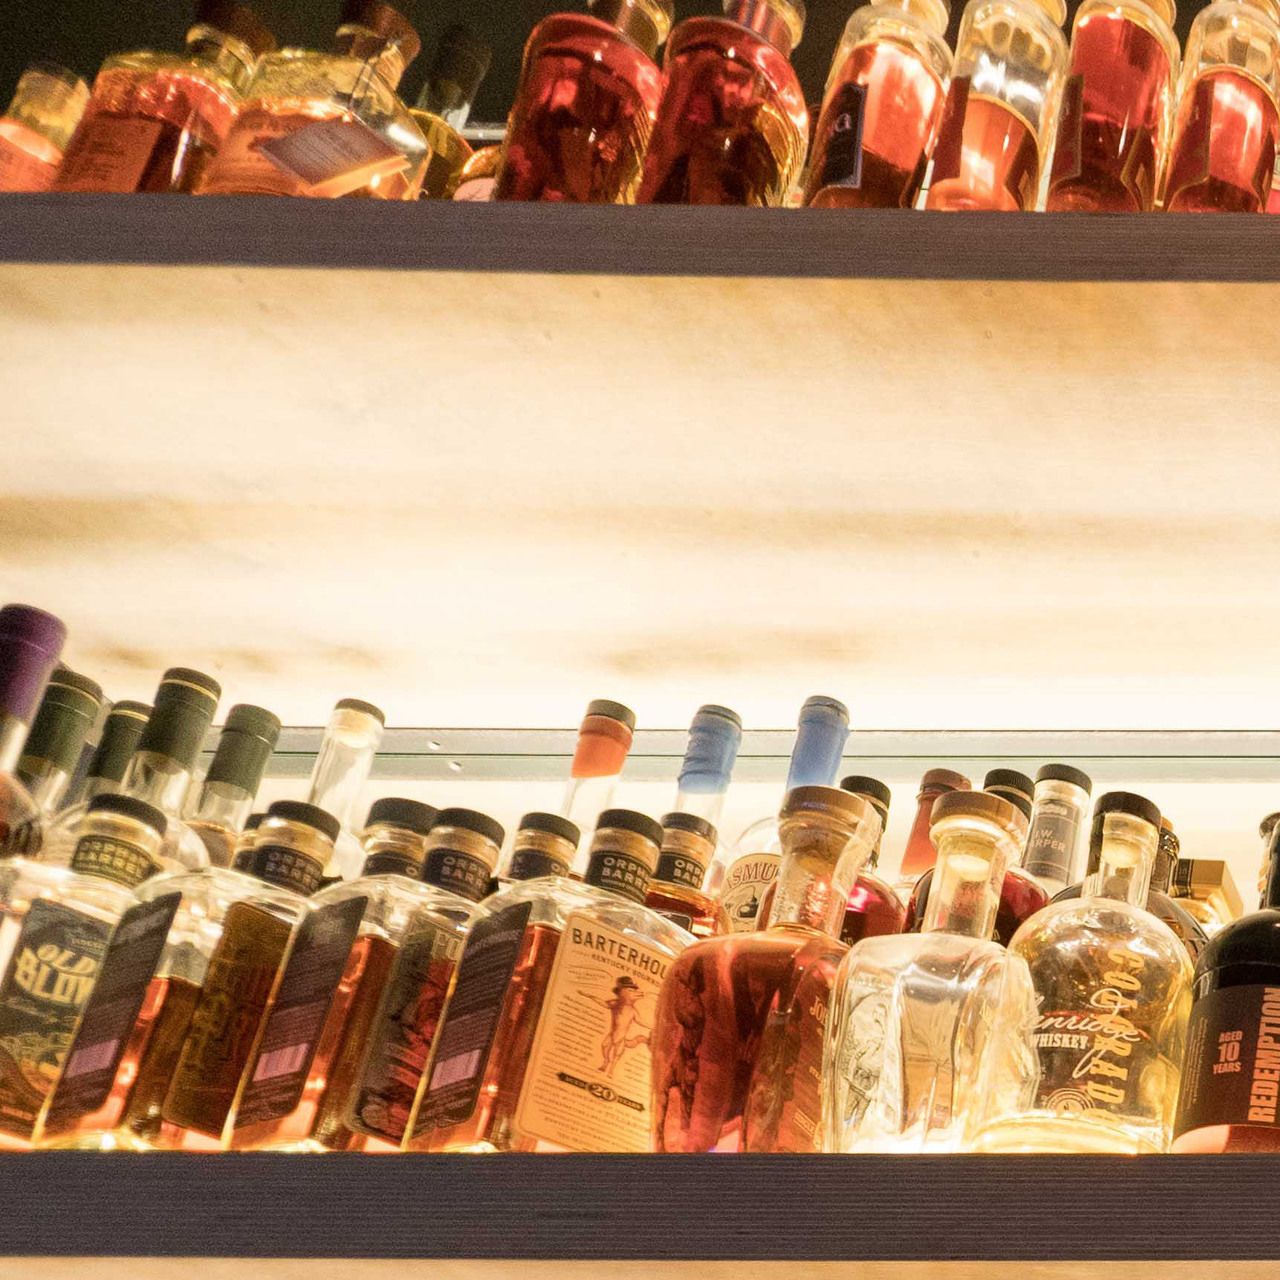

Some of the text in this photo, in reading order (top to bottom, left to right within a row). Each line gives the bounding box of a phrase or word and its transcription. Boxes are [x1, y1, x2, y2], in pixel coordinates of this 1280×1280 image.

[37, 944, 98, 976] OLD
[1030, 1033, 1089, 1050] WHISKEY
[1219, 1030, 1243, 1043] AGED
[1218, 1041, 1241, 1063] 10
[1213, 1061, 1242, 1075] YEARS
